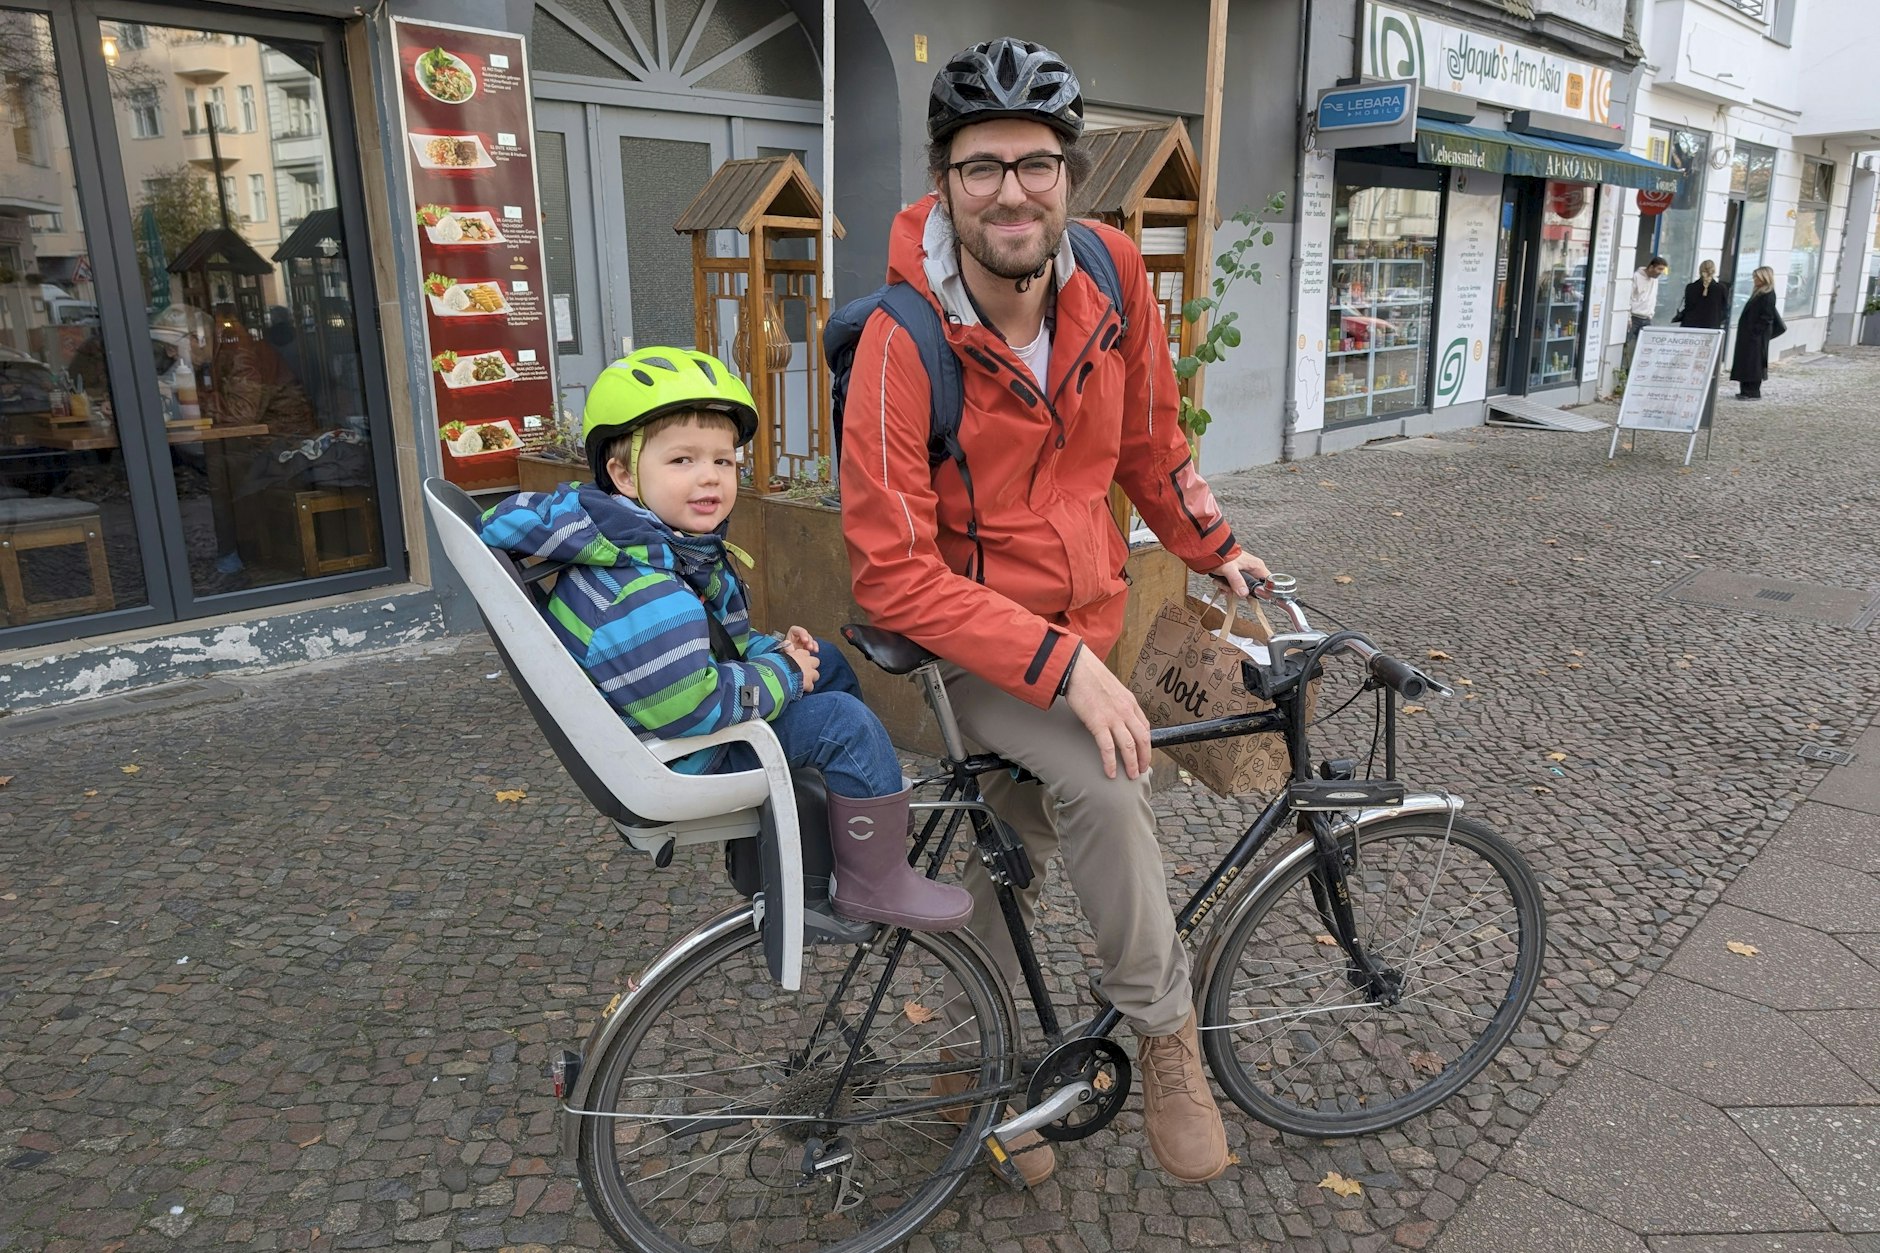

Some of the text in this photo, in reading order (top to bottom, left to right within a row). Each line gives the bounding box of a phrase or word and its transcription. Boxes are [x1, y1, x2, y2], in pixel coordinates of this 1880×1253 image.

[1511, 50, 1537, 88] Afro
[1539, 62, 1561, 94] Asia
[1347, 95, 1401, 111] LEBARA
[1354, 107, 1401, 117] MOBILE
[1431, 143, 1486, 168] Lebensmittel
[1545, 155, 1603, 181] AFRO ASIA
[1651, 336, 1711, 347] TOP ANGEBOTE
[1190, 866, 1239, 925] miyata
